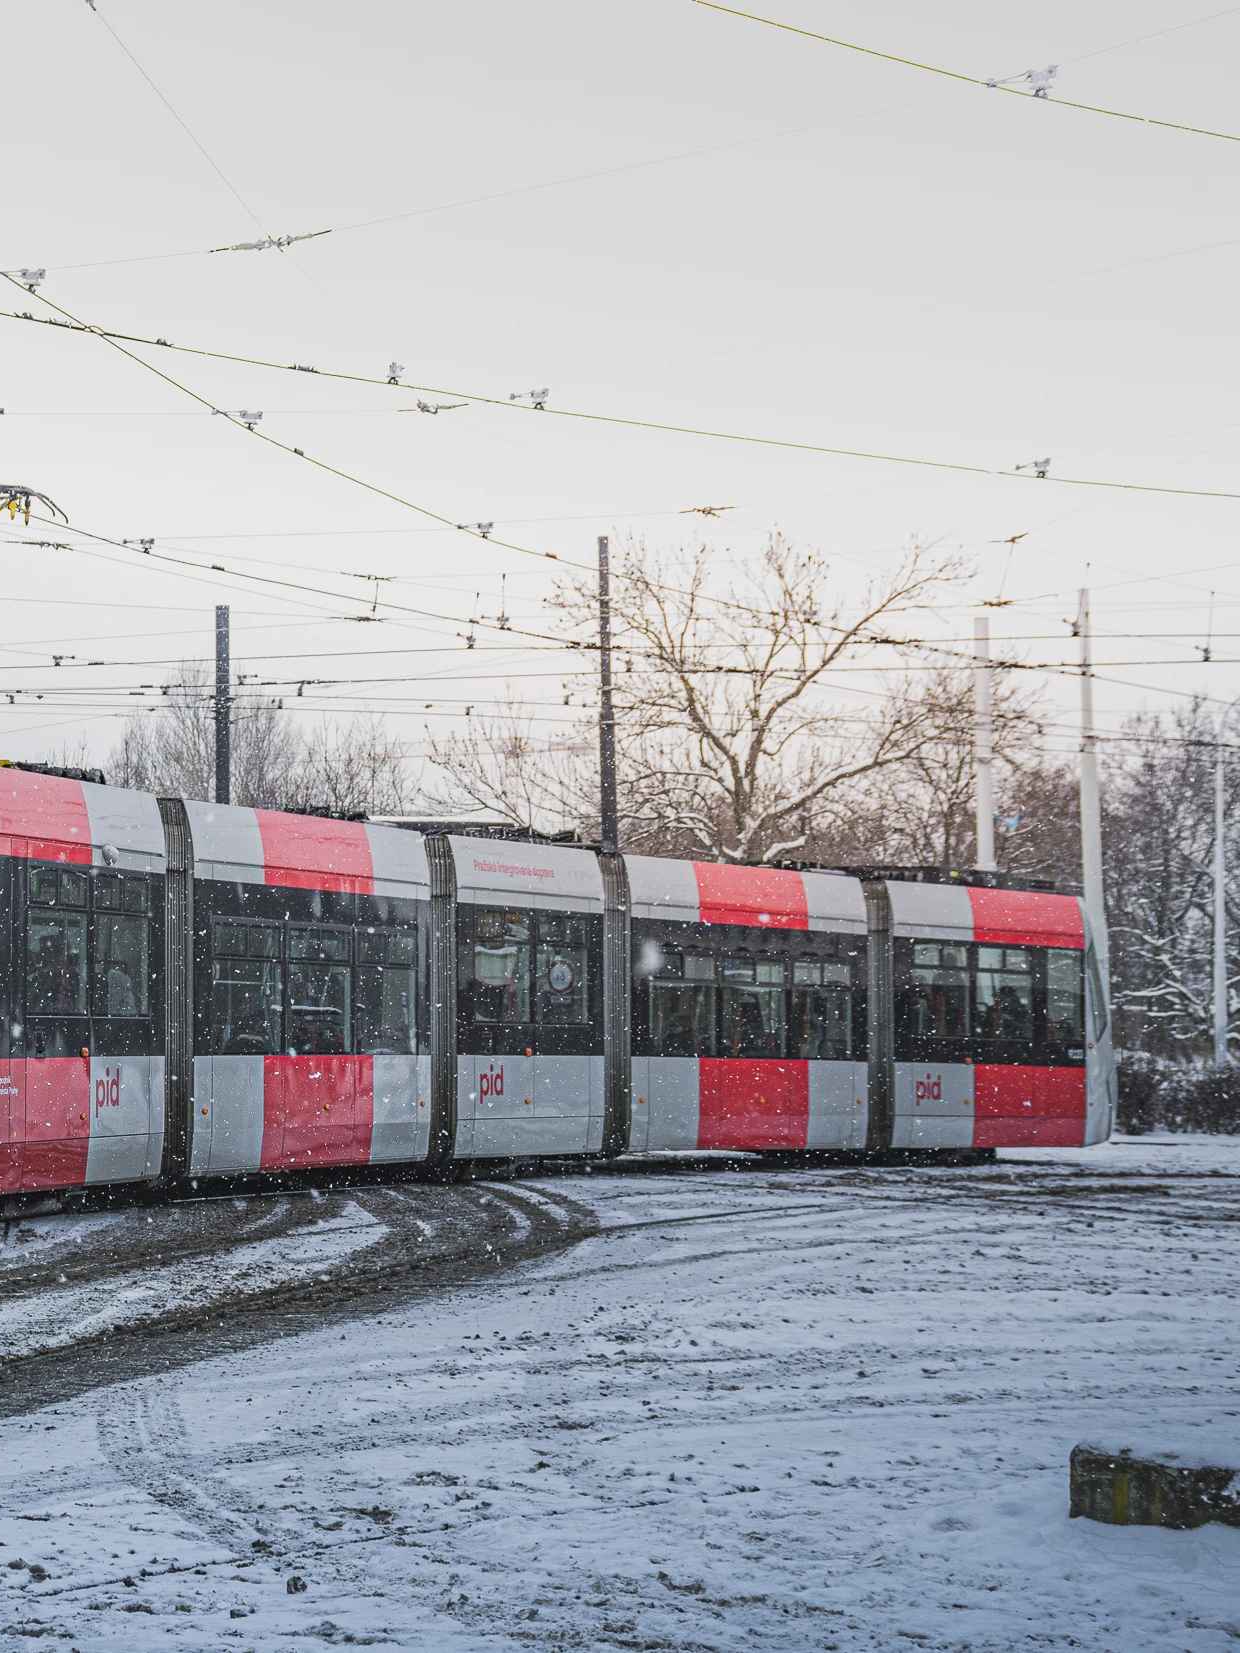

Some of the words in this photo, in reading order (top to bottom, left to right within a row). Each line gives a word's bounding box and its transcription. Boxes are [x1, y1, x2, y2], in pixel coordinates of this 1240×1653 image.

[95, 1066, 120, 1119] pid
[479, 1063, 504, 1105] pid
[915, 1073, 942, 1107] pid
